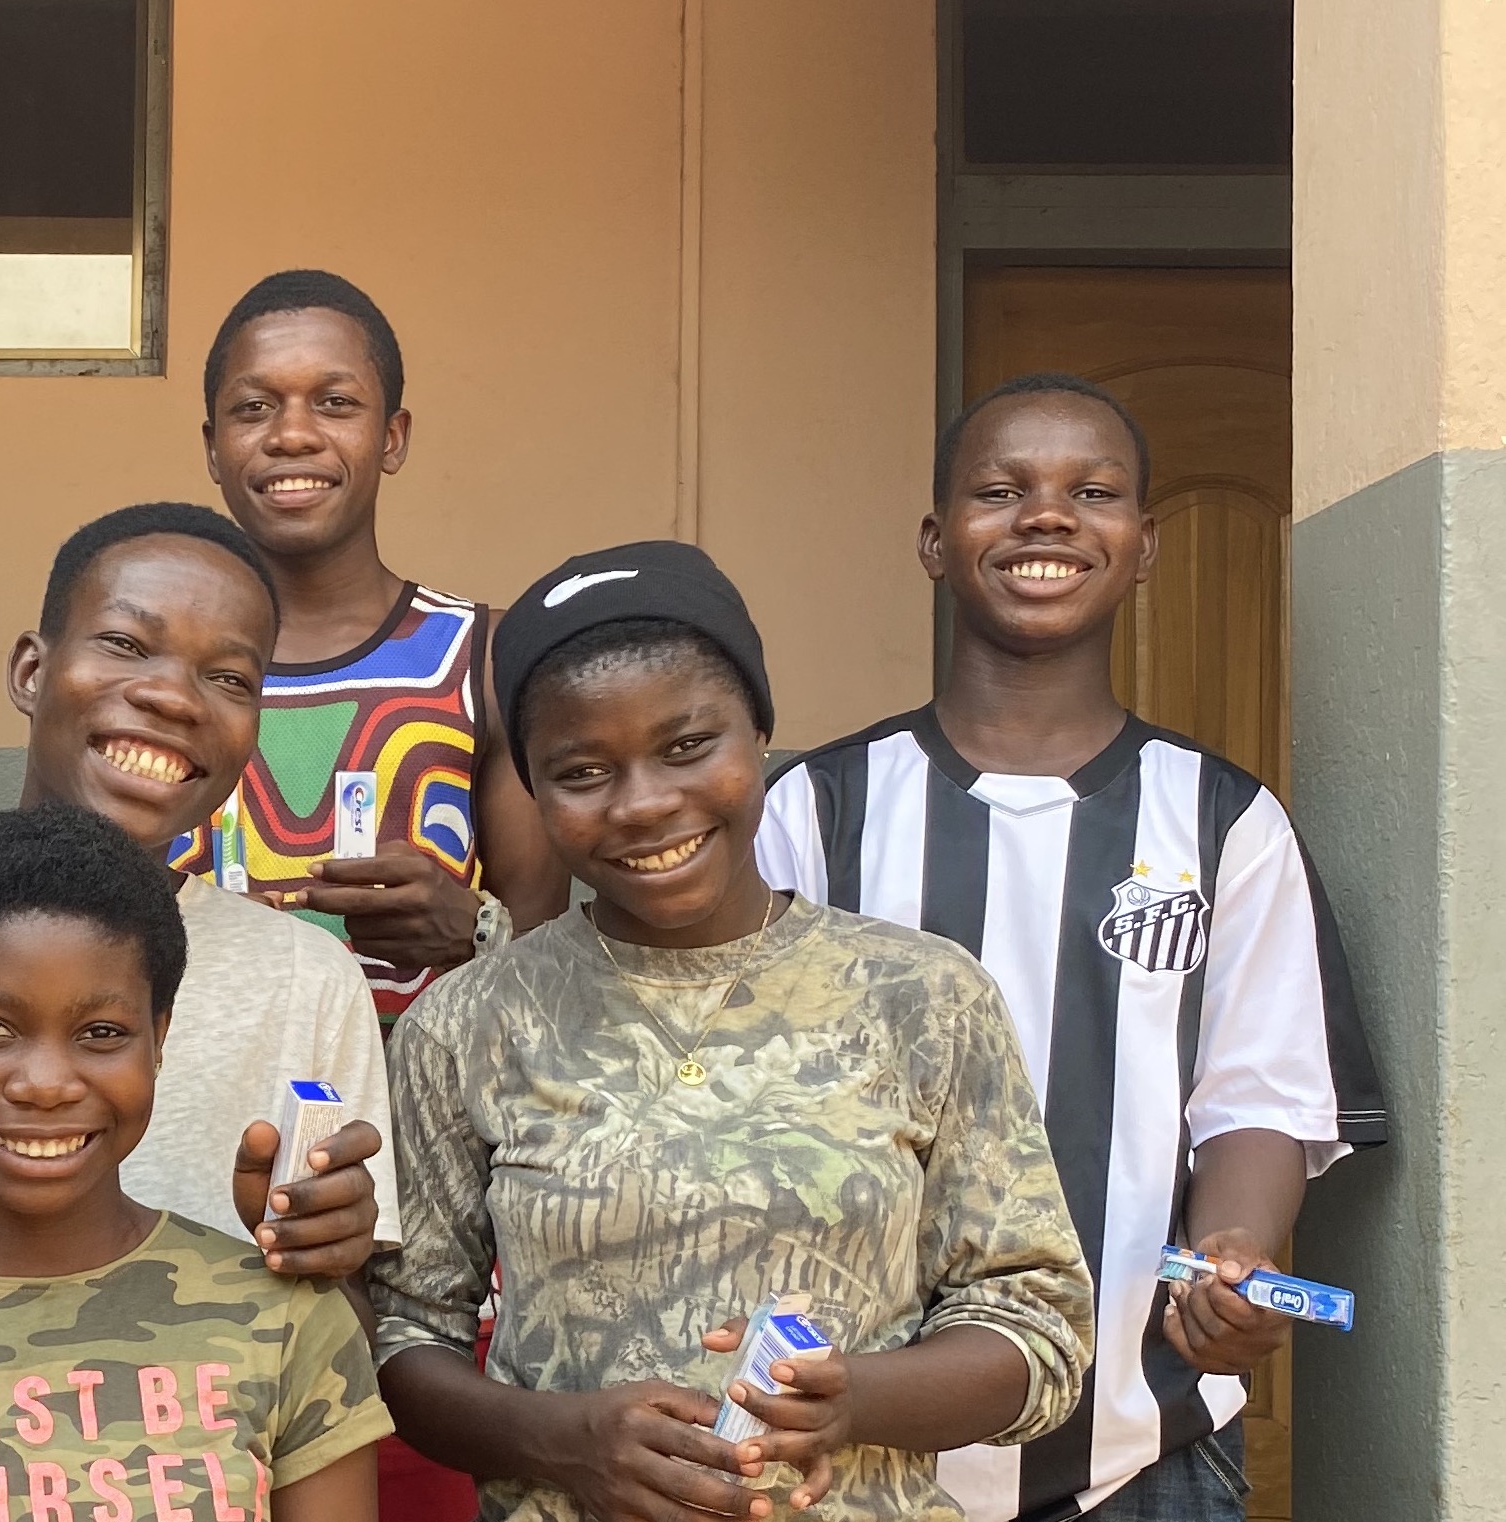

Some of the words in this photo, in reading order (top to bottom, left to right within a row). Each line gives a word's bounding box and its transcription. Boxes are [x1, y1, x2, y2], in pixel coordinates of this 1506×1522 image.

[355, 786, 366, 835] Crest
[1113, 895, 1197, 936] S.F.C.
[137, 1362, 238, 1436] BE
